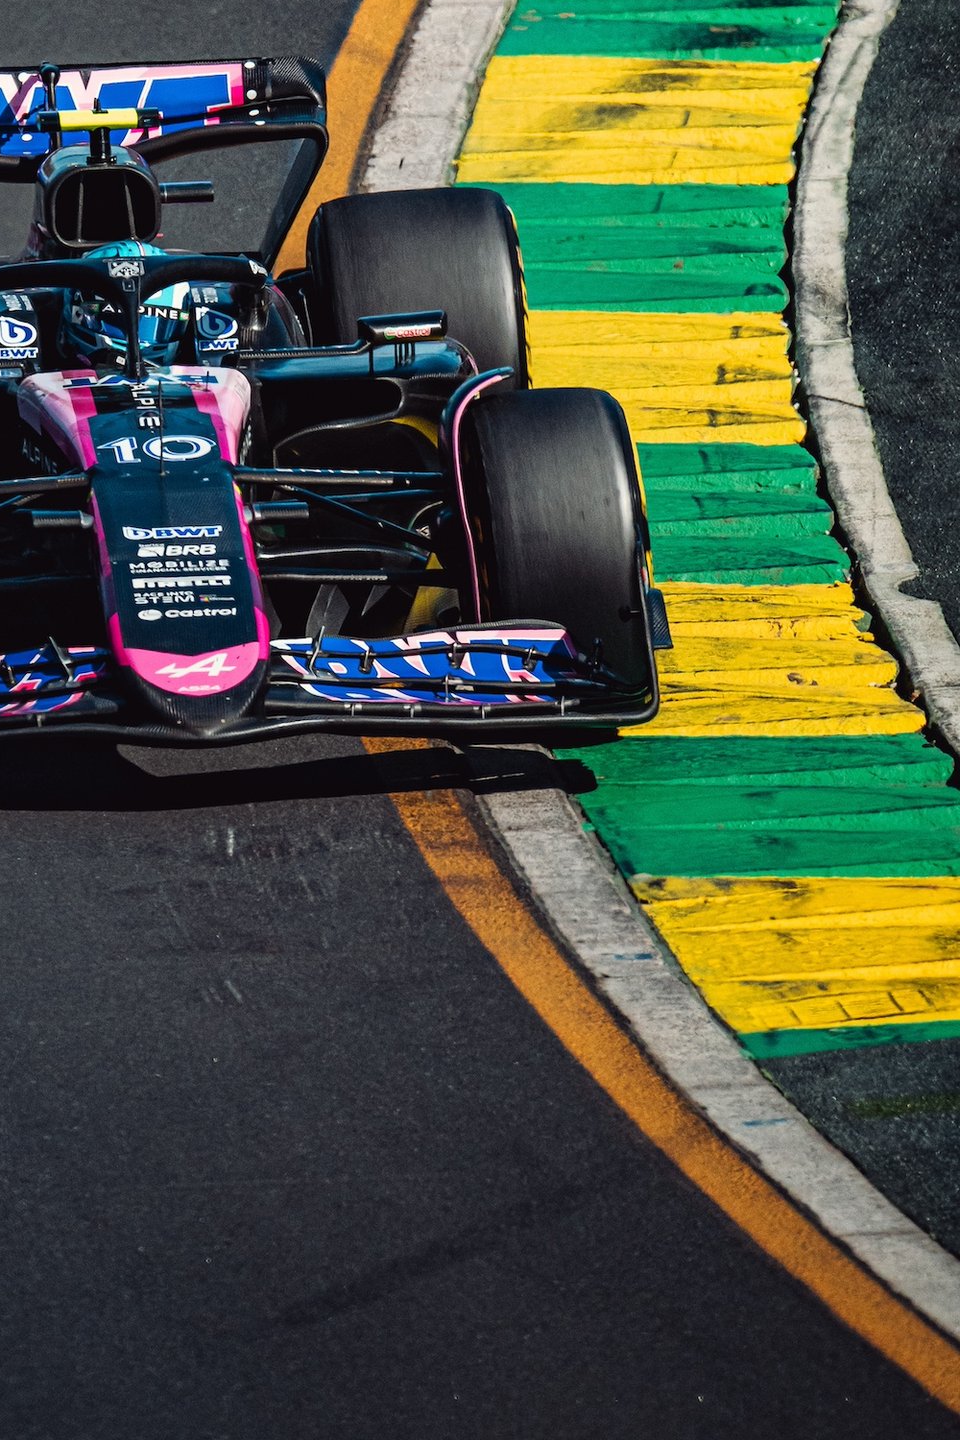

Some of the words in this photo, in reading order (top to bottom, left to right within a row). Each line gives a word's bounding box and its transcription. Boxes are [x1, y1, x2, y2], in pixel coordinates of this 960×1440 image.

[102, 304, 178, 320] APINE
[396, 327, 431, 338] Castrol
[200, 338, 239, 350] BWT
[0, 348, 38, 358] BWT
[97, 435, 217, 463] 10
[153, 526, 222, 539] BWT
[166, 544, 217, 556] BRB
[129, 559, 230, 569] MOBILIZE
[132, 575, 232, 588] PIRELLI
[134, 595, 195, 604] STEM
[165, 607, 237, 618] Castrol
